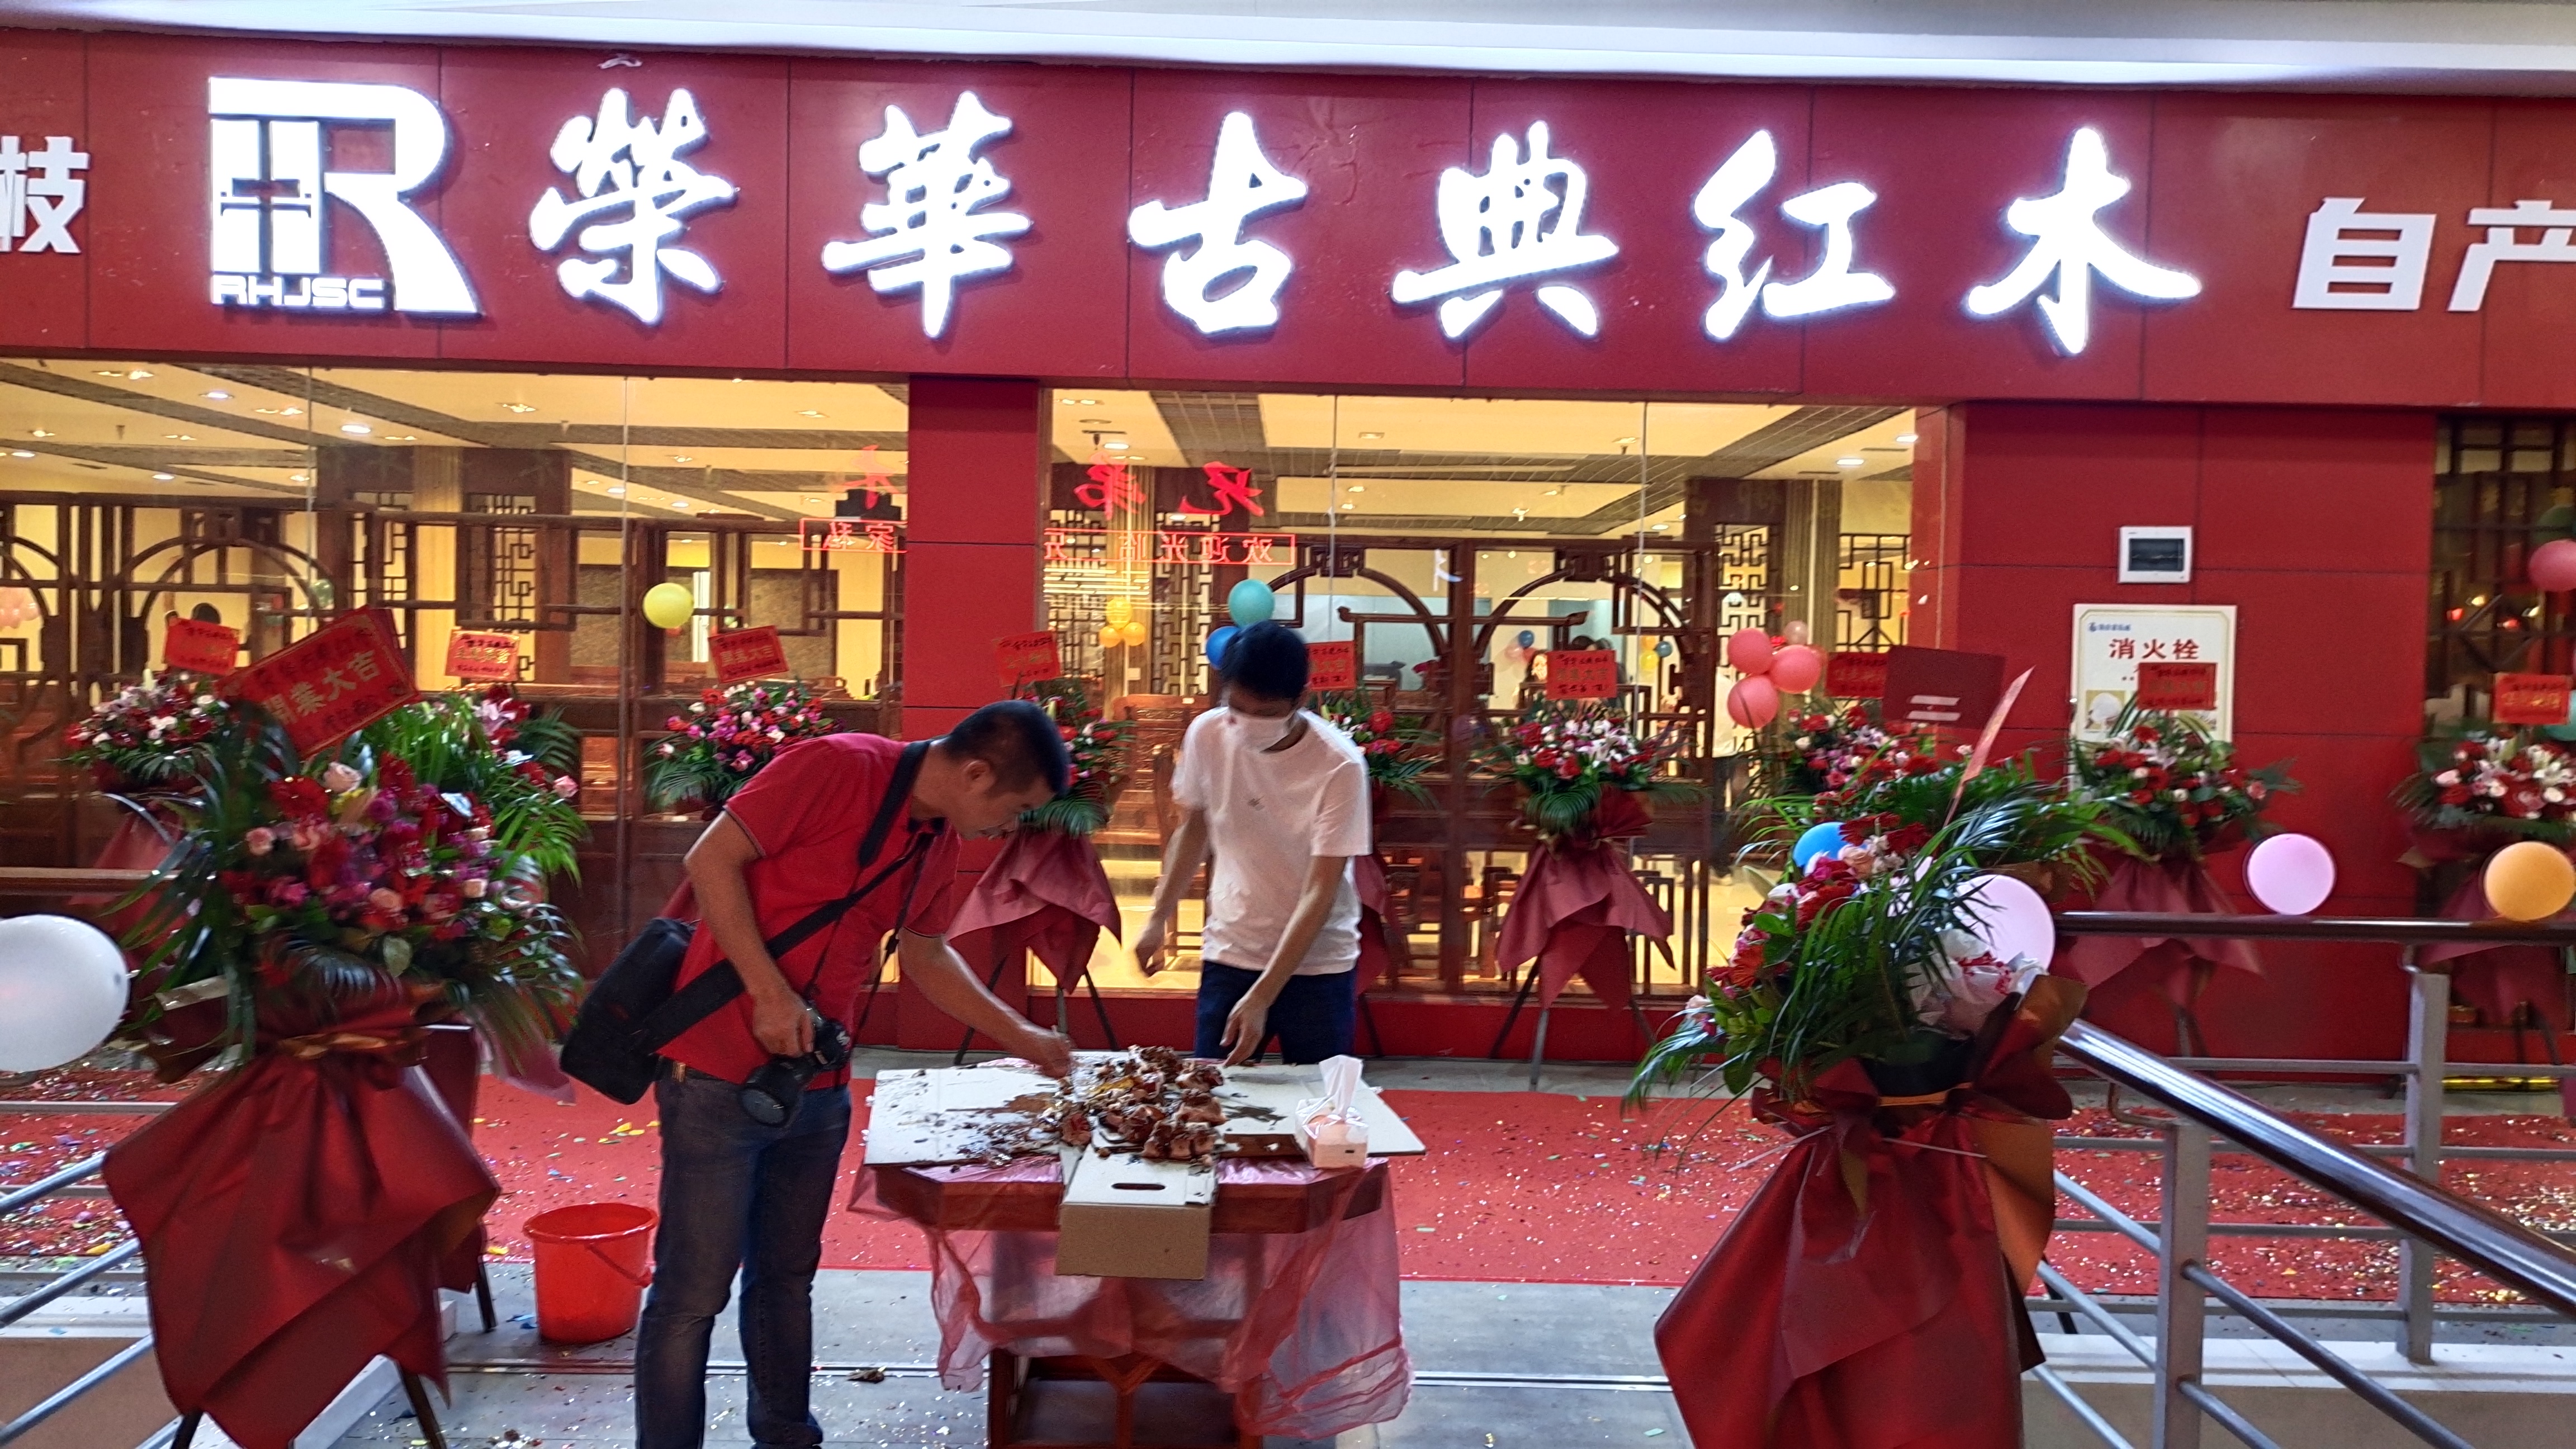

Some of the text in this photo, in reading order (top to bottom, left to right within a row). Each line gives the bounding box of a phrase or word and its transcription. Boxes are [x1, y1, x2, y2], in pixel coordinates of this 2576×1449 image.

[0, 135, 91, 253] 枝
[529, 87, 2204, 356] 榮華古典红木
[211, 275, 386, 307] RHJSC
[2291, 197, 2576, 312] 自产
[2108, 638, 2200, 660] 消火栓
